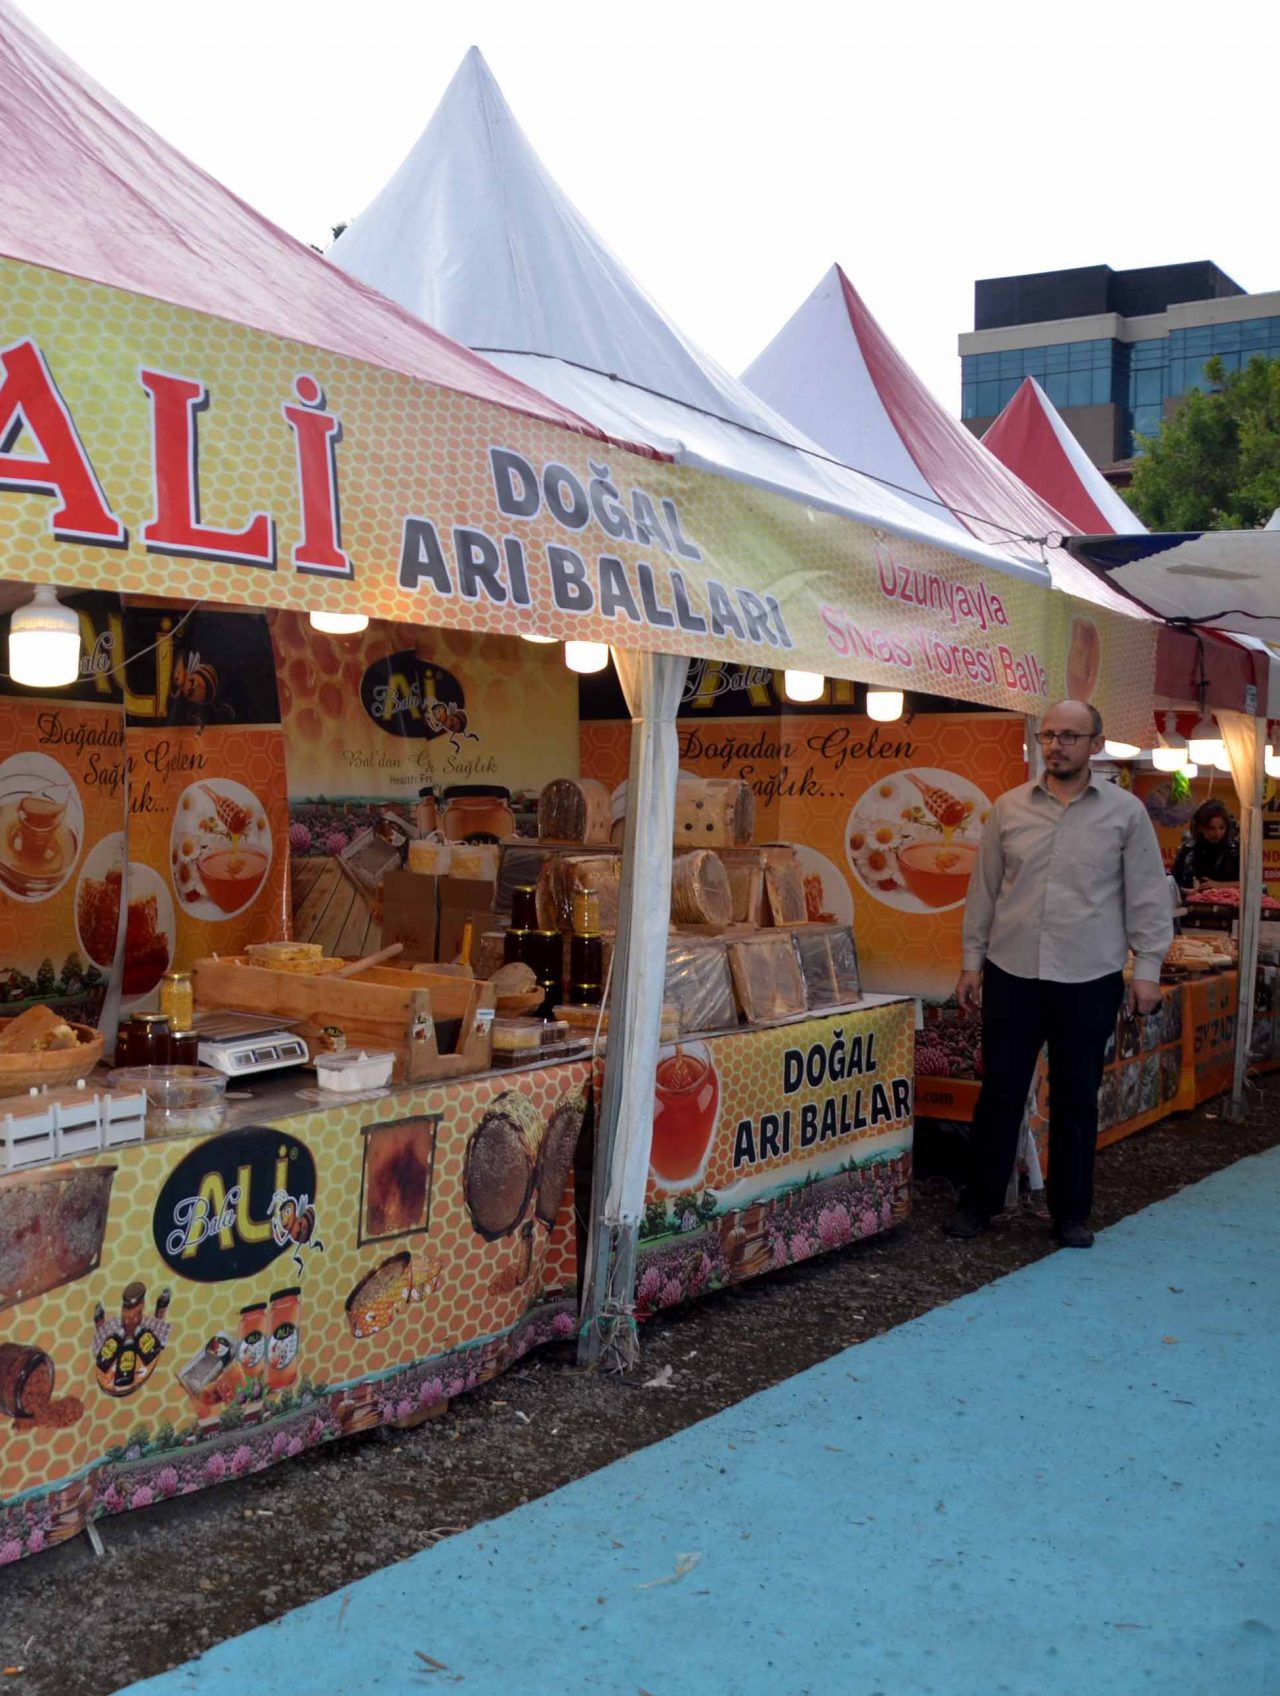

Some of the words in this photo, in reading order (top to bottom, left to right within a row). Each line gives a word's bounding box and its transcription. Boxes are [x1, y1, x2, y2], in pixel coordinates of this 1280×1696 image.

[489, 447, 703, 562] DOĞAL
[398, 515, 530, 606] ARI
[546, 543, 794, 649] BALLARI
[821, 603, 913, 668] Sivas
[442, 754, 497, 780] Sağlık
[677, 728, 794, 769] Doğadan
[806, 727, 918, 770] Gelen
[784, 1028, 877, 1095] DOĞAL
[733, 1110, 791, 1168] ARI
